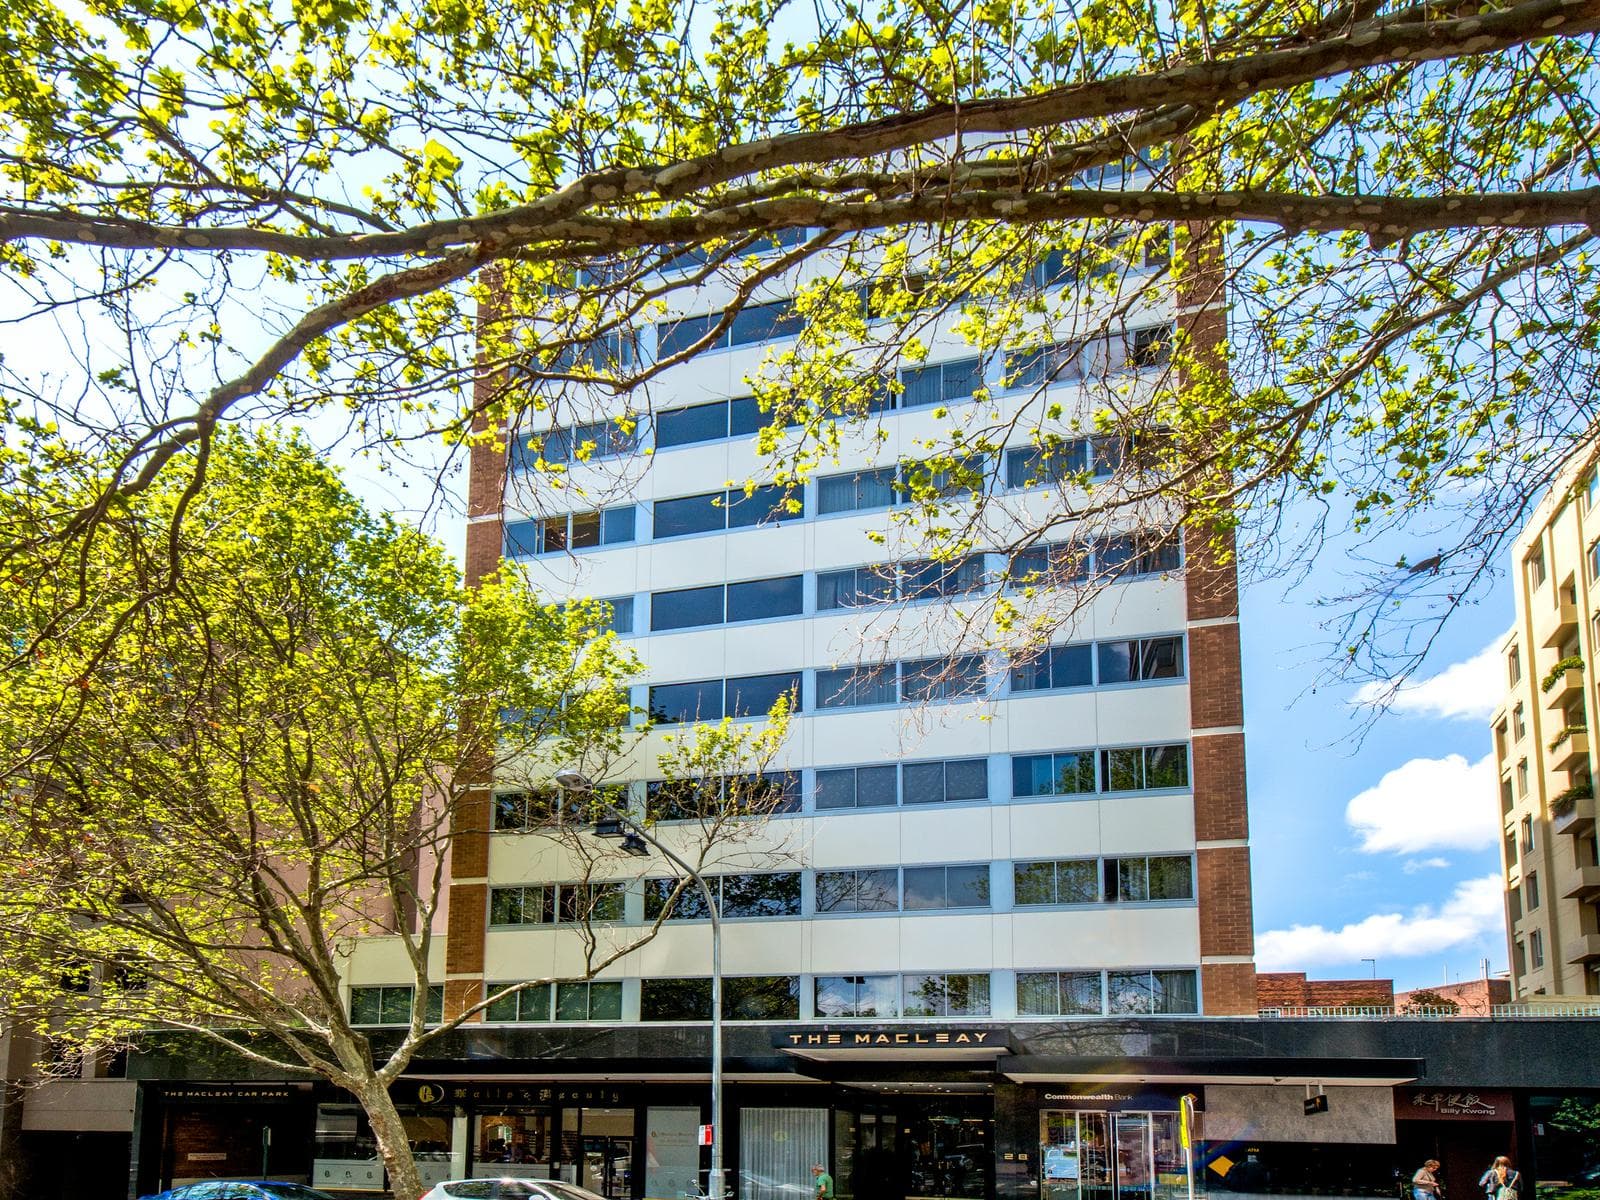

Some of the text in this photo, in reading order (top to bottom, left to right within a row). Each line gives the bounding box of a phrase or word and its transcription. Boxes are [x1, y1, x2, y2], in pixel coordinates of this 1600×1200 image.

[790, 1033, 987, 1044] THE MACLEAY
[1044, 1093, 1114, 1101] Commonwealth
[1440, 1107, 1496, 1116] Billy Kwong
